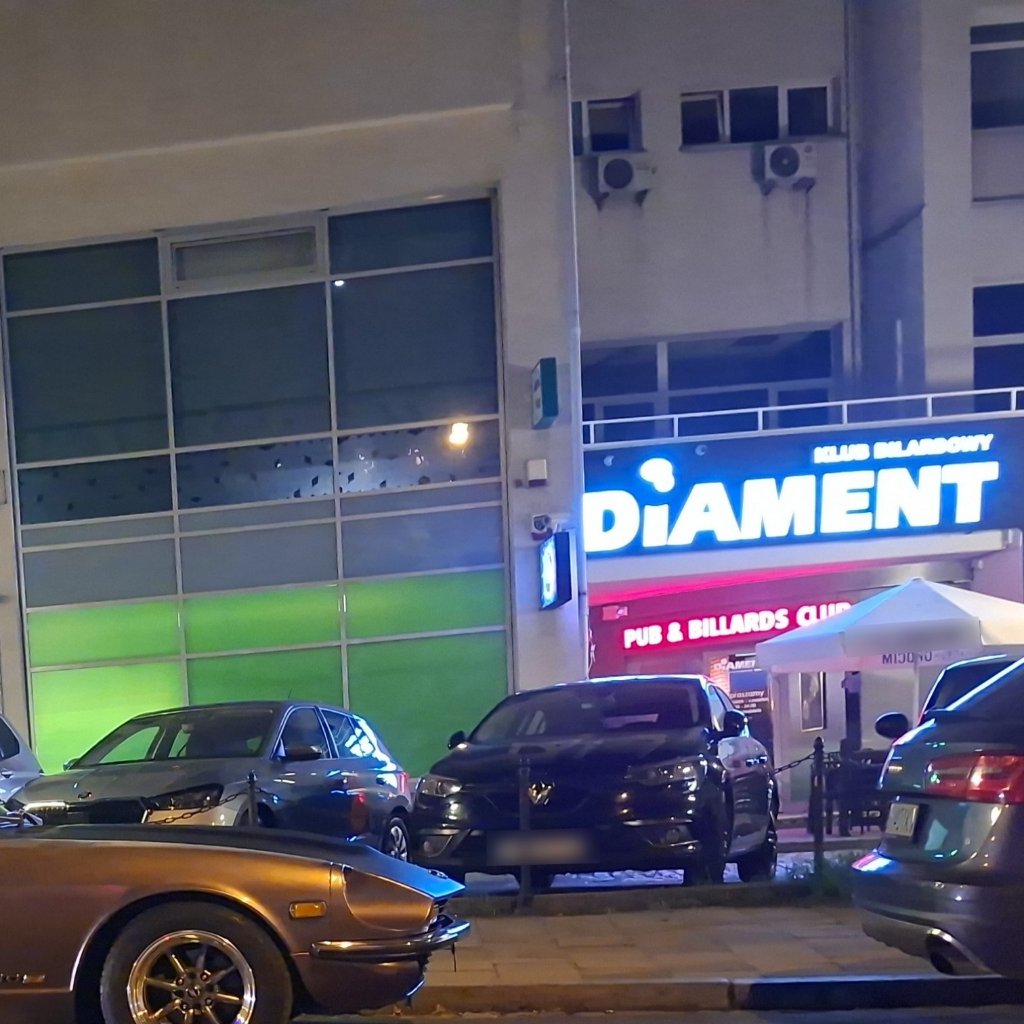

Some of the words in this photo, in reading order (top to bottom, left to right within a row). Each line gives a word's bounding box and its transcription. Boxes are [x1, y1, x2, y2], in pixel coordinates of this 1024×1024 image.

[814, 443, 870, 463] KLUB
[624, 620, 662, 649] PUB
[667, 621, 684, 643] &
[688, 608, 789, 640] BILLARDS
